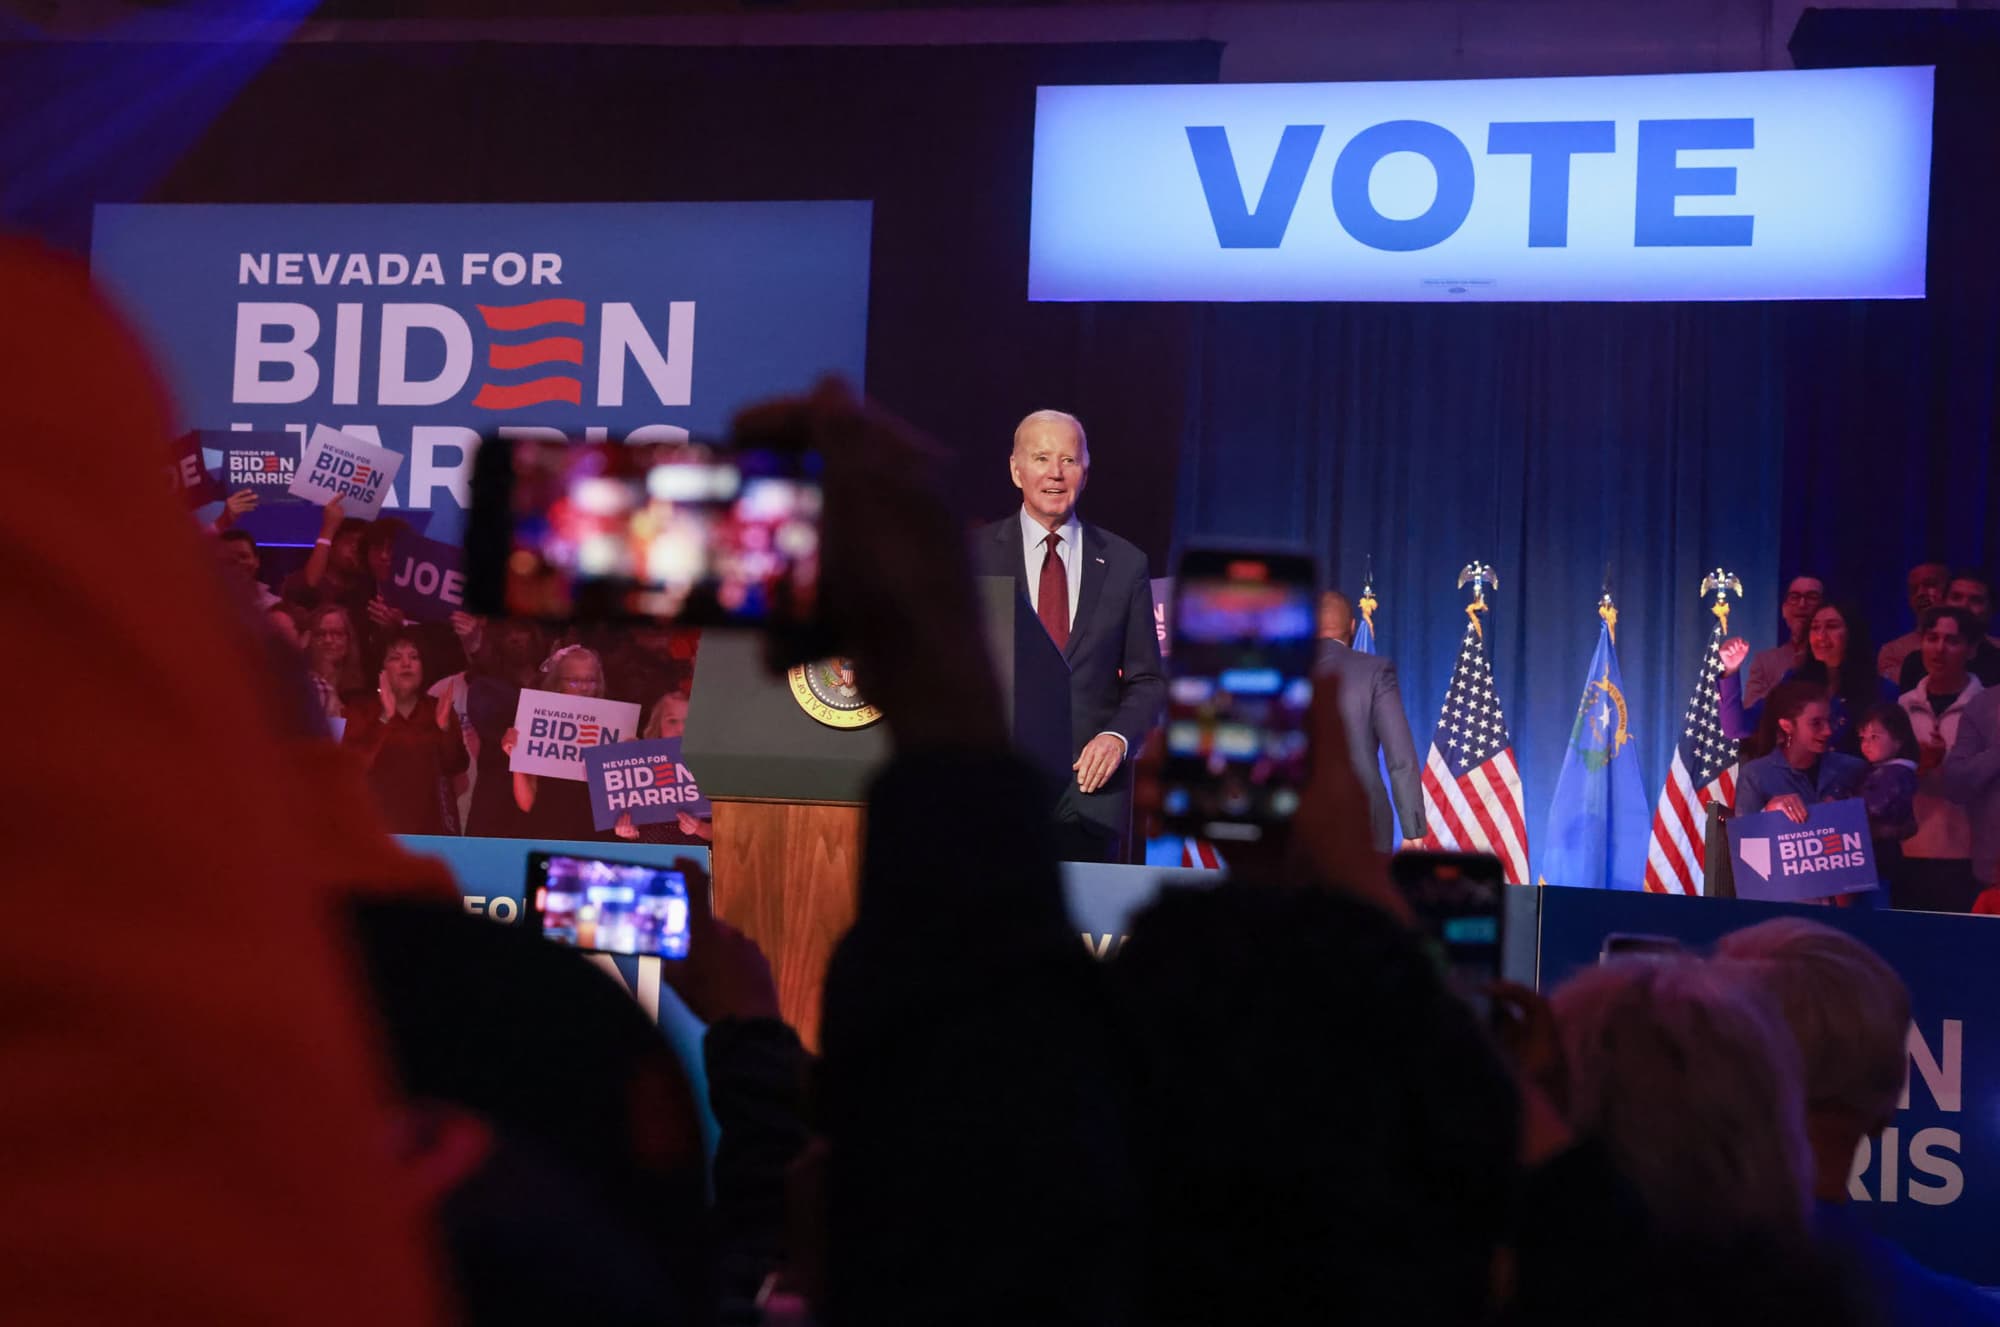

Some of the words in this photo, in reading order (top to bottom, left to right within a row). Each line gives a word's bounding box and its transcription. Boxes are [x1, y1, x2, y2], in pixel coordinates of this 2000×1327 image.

[1185, 118, 1755, 252] VOTE
[238, 253, 446, 286] NEVADA
[461, 252, 563, 286] FOR
[232, 298, 696, 411] BIDEN
[229, 455, 295, 472] BIDEN
[315, 450, 385, 489] BIDEN
[230, 471, 295, 485] HARRIS
[308, 469, 377, 504] HARRIS
[394, 556, 466, 606] JOE
[533, 707, 574, 720] NEVADA
[576, 714, 597, 723] FOR
[529, 717, 620, 745] BIDEN
[602, 757, 646, 769] NEVADA
[647, 754, 668, 764] FOR
[603, 762, 696, 792] BIDEN
[607, 784, 700, 811] HARRIS
[1777, 830, 1816, 841] NEVADA
[1816, 827, 1836, 836] FOR
[1779, 832, 1862, 860] BIDEN
[1782, 851, 1865, 876] HARRIS
